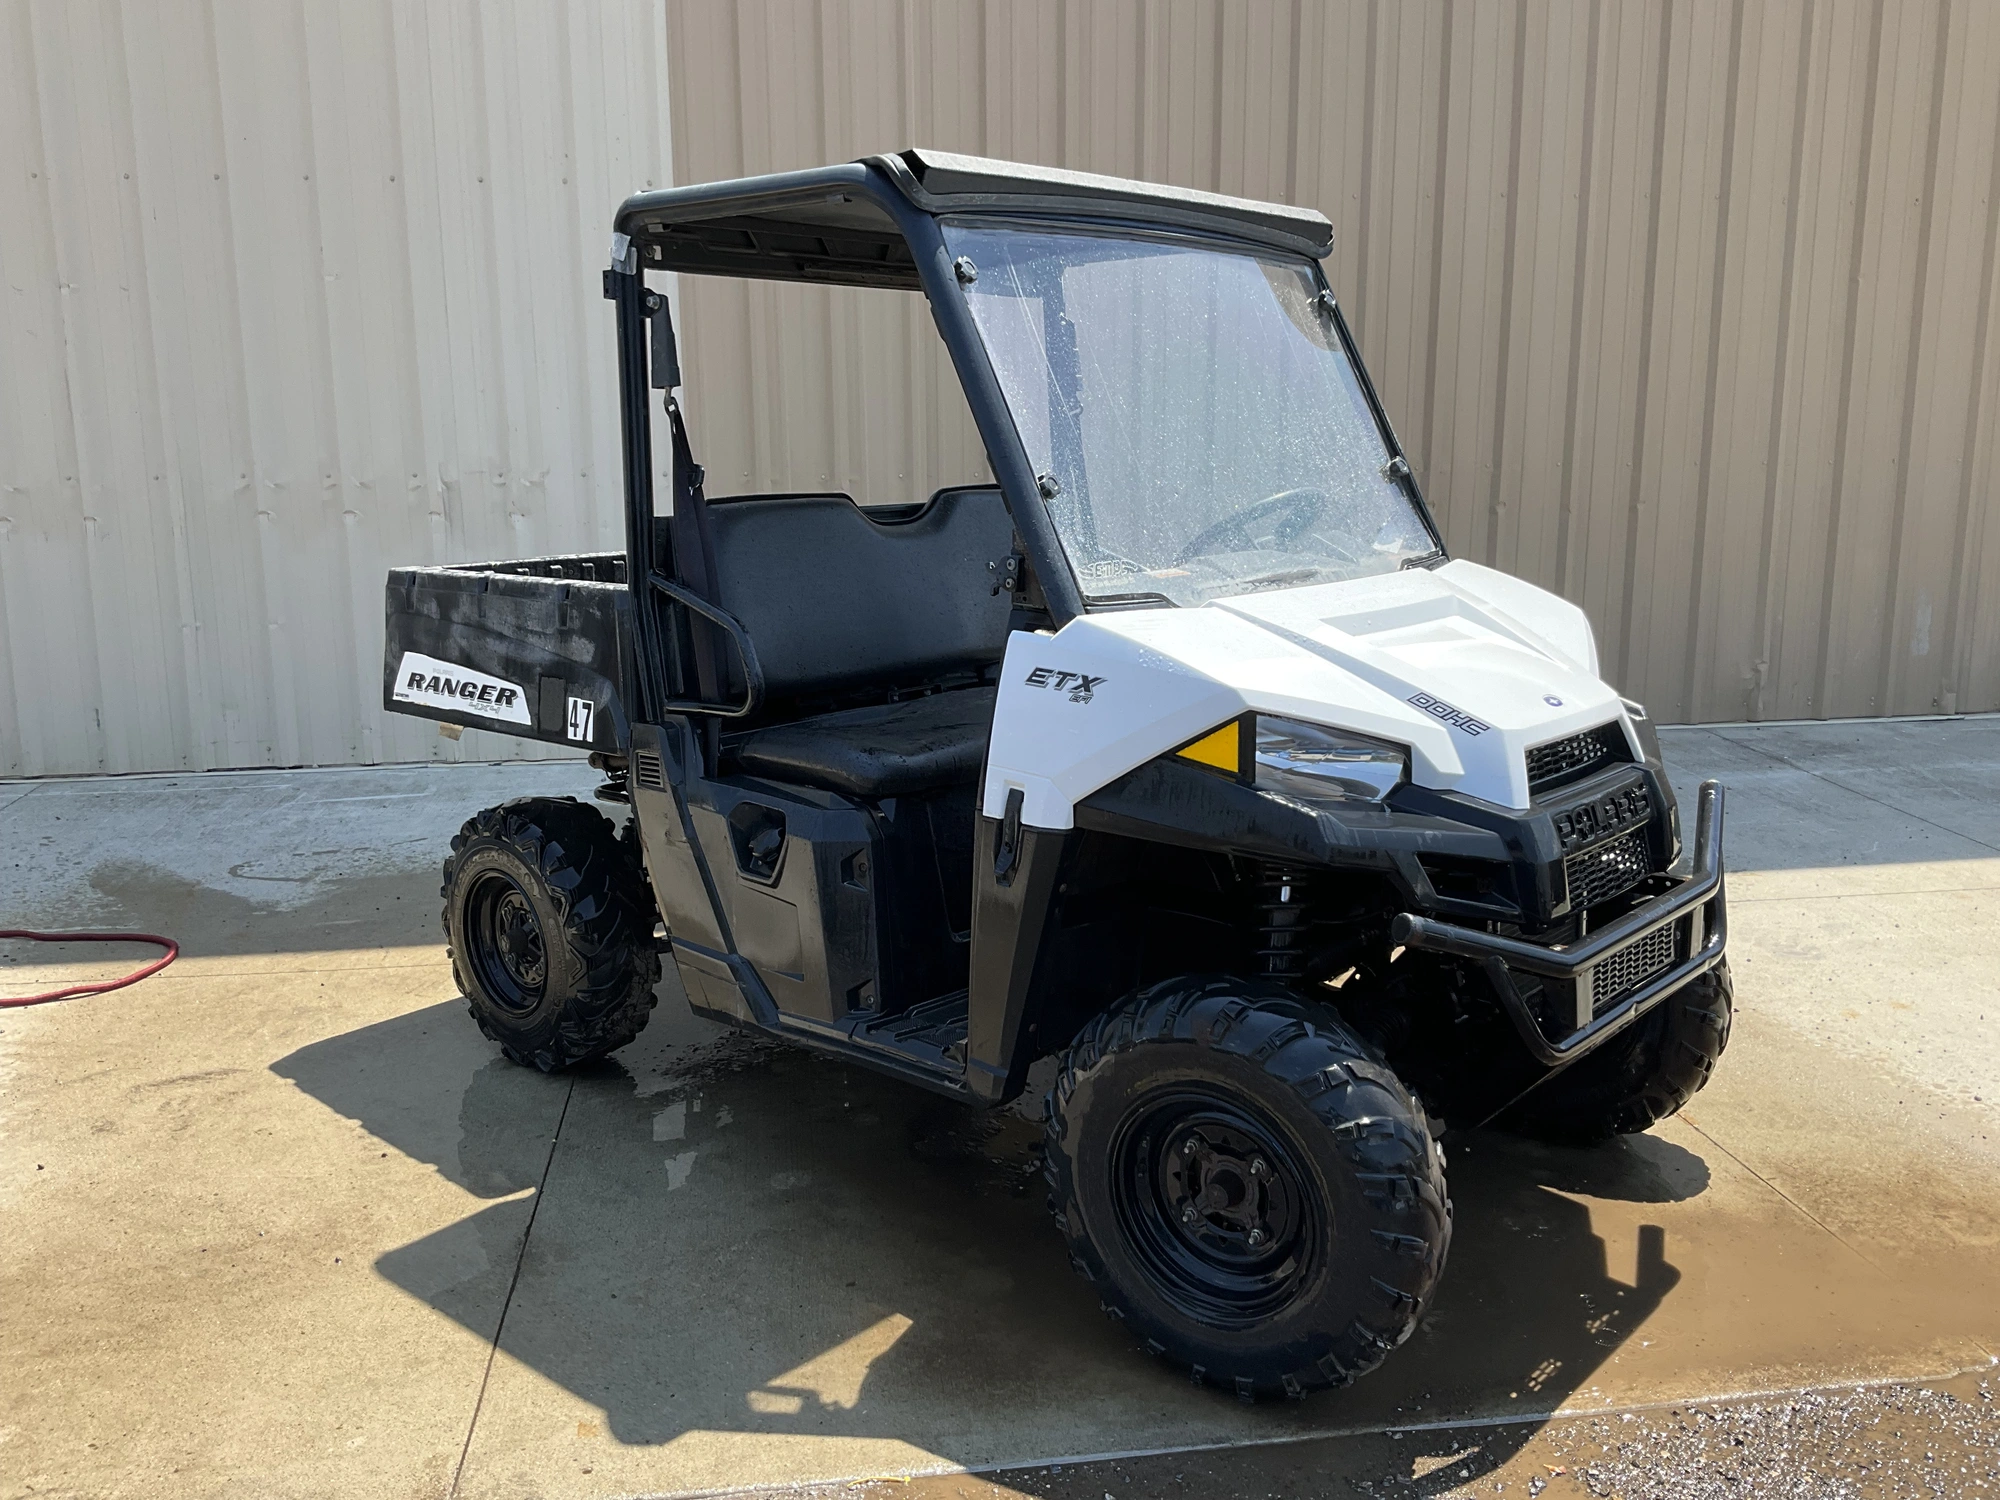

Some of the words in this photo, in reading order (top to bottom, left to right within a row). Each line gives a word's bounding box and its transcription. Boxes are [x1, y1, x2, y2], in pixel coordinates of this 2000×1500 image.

[407, 672, 519, 708] RANGER
[1024, 666, 1108, 697] ETX
[1068, 693, 1092, 704] EFI
[569, 699, 593, 742] 47
[1406, 692, 1490, 736] DOHC
[1553, 783, 1651, 851] POLARIS
